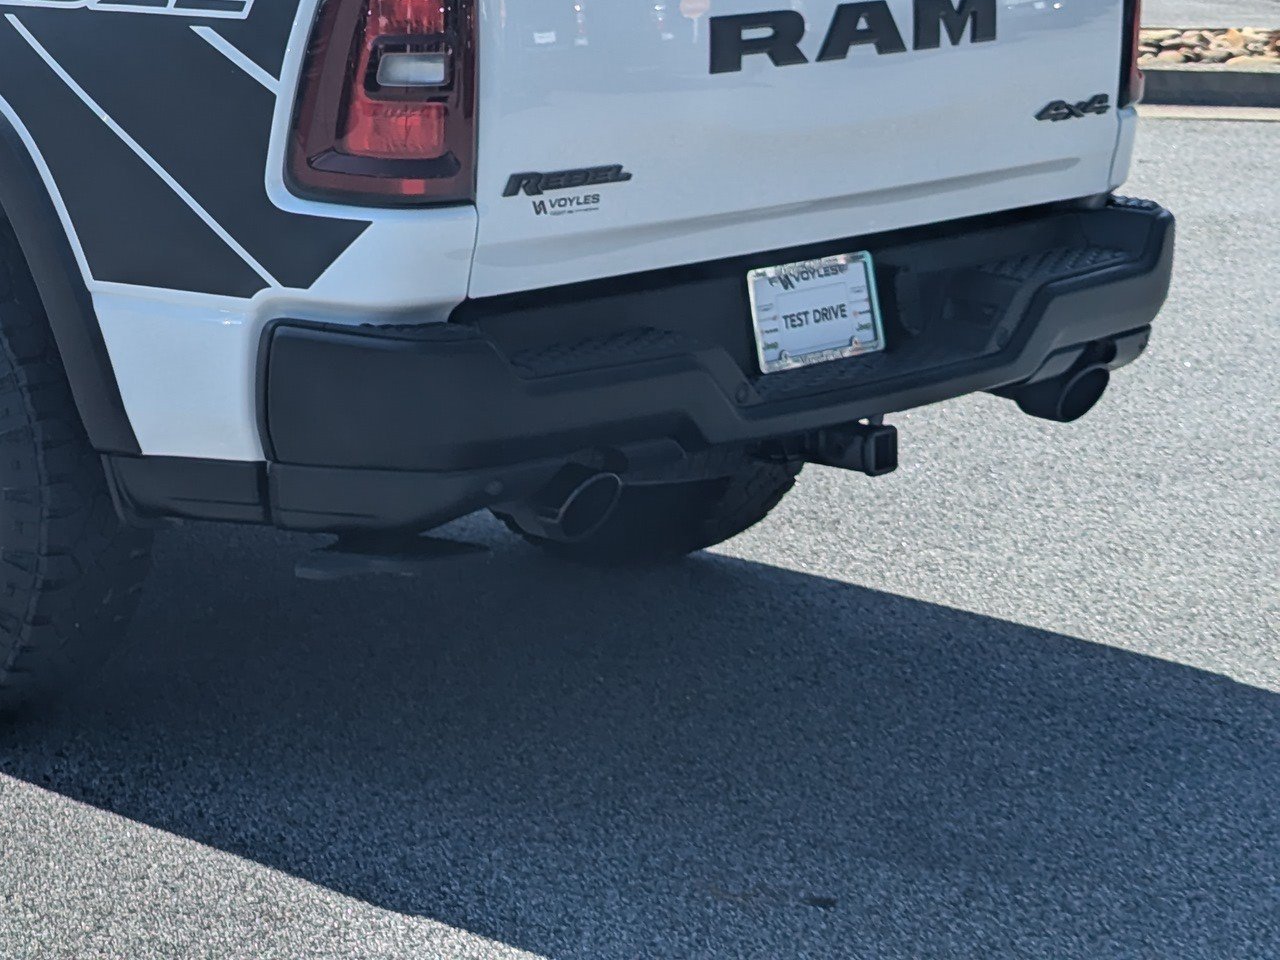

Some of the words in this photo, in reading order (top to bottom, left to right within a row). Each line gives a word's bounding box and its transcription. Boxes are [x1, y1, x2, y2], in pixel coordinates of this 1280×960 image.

[1033, 92, 1111, 122] 4x4
[501, 163, 633, 198] REBEL
[548, 193, 601, 209] VOYLES
[782, 310, 810, 330] TEST
[812, 303, 848, 324] DRIVE
